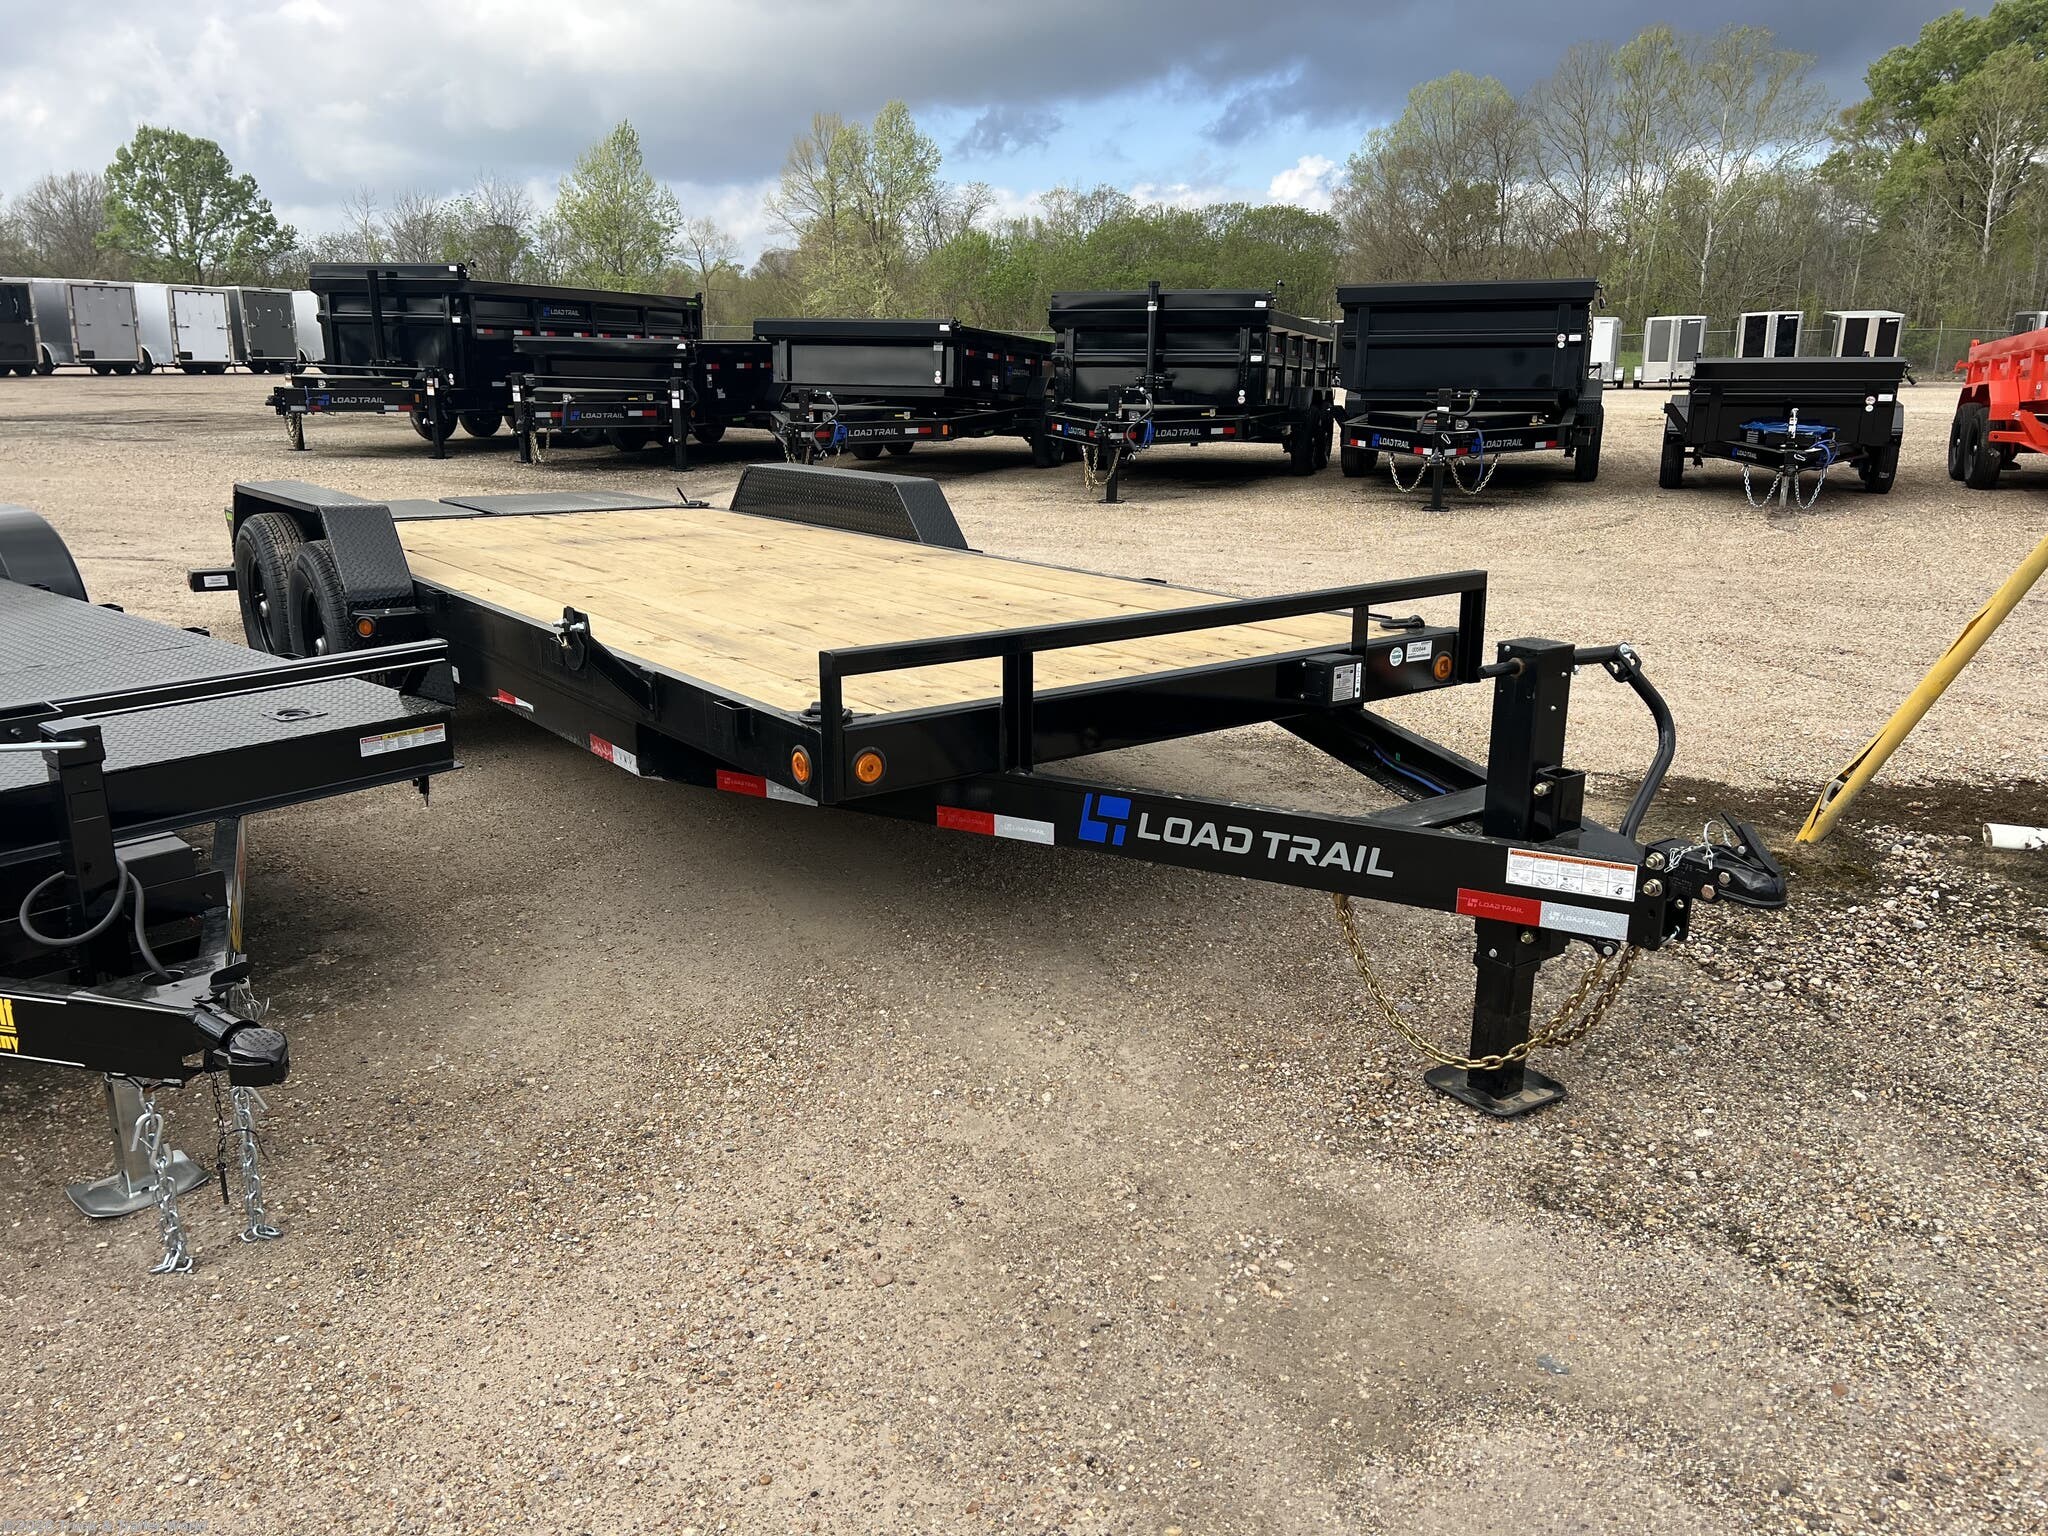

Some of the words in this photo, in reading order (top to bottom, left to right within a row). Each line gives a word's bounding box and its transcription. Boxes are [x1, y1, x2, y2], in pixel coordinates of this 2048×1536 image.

[331, 396, 357, 404] LOAD
[358, 396, 385, 404] TRAIL
[848, 429, 873, 437] LOAD
[873, 428, 898, 436] TRAIL
[1155, 429, 1178, 437] LOAD
[1178, 428, 1201, 436] TRAIL
[1379, 436, 1394, 446] LOAD
[1394, 439, 1410, 449] TRAIL
[1481, 439, 1502, 448] LOAD
[1502, 438, 1523, 447] TRAIL
[1136, 812, 1254, 854] LOAD
[1261, 831, 1394, 878] TRAIL
[1479, 901, 1500, 910] LOAD
[1500, 905, 1524, 914] TRAIL
[1560, 915, 1584, 924] LOAD
[1583, 918, 1609, 929] TRAIL
